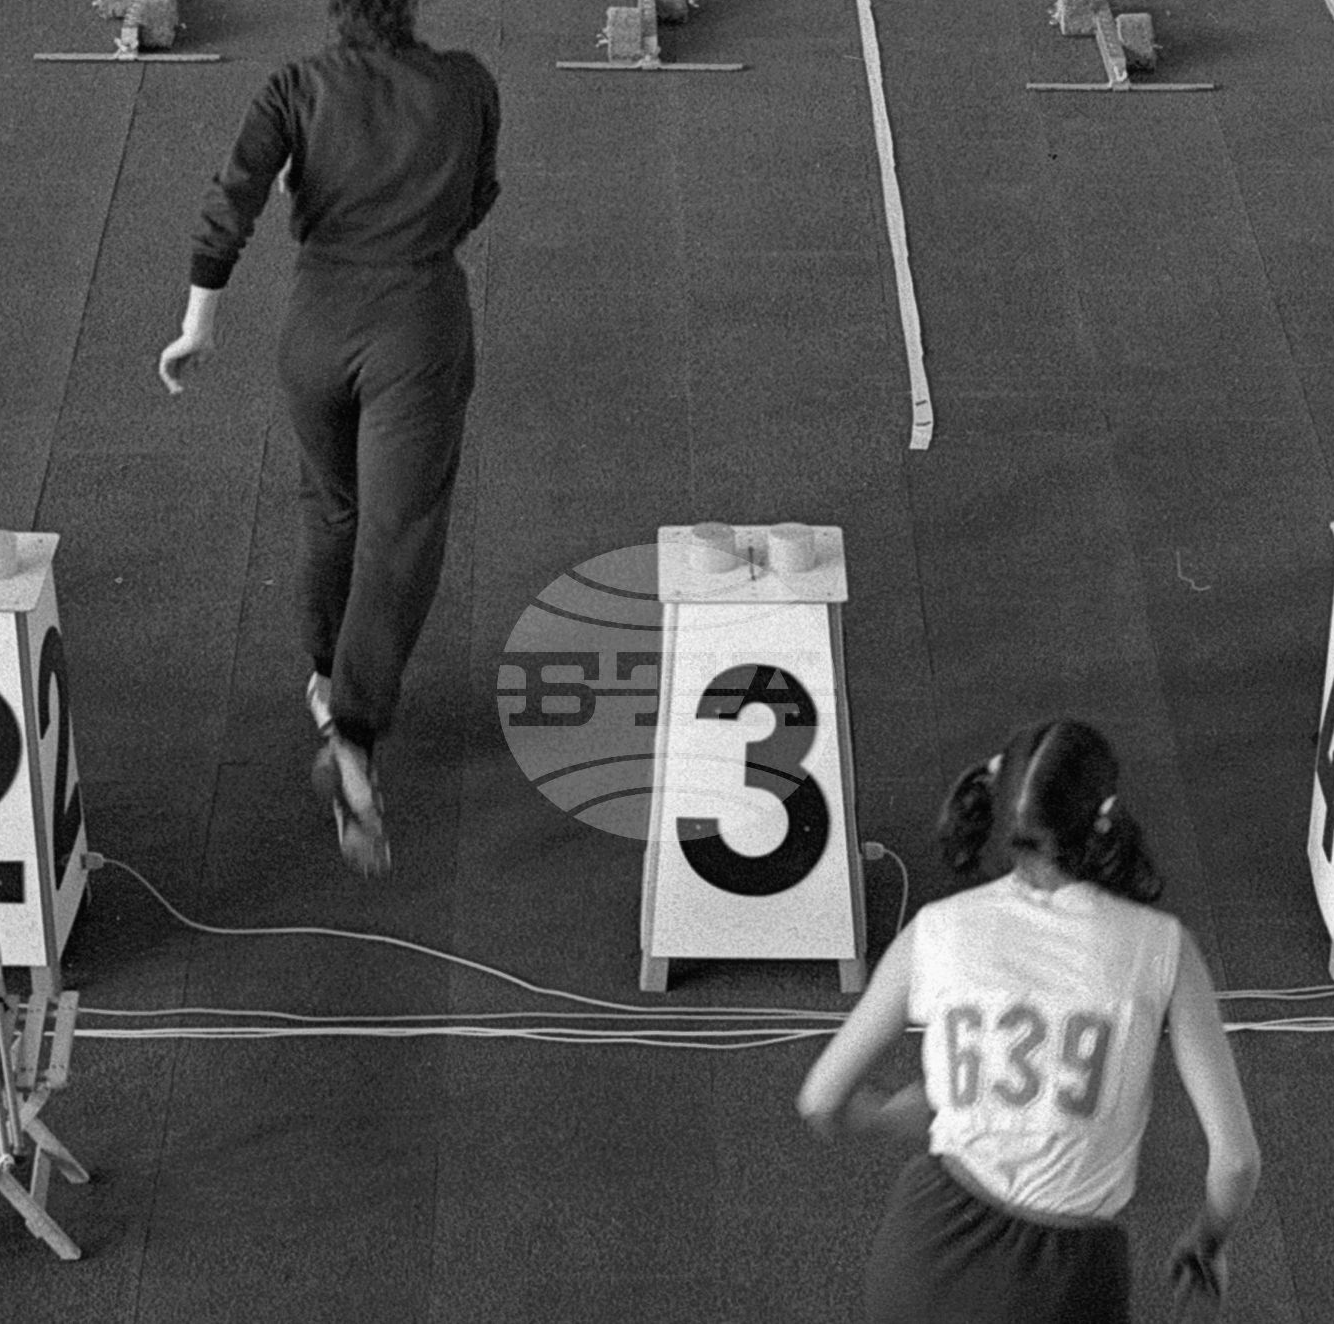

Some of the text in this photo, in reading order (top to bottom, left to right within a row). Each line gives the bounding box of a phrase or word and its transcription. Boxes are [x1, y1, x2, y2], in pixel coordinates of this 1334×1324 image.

[38, 625, 83, 891] 2
[676, 663, 831, 897] 3
[945, 1006, 1112, 1120] 639
